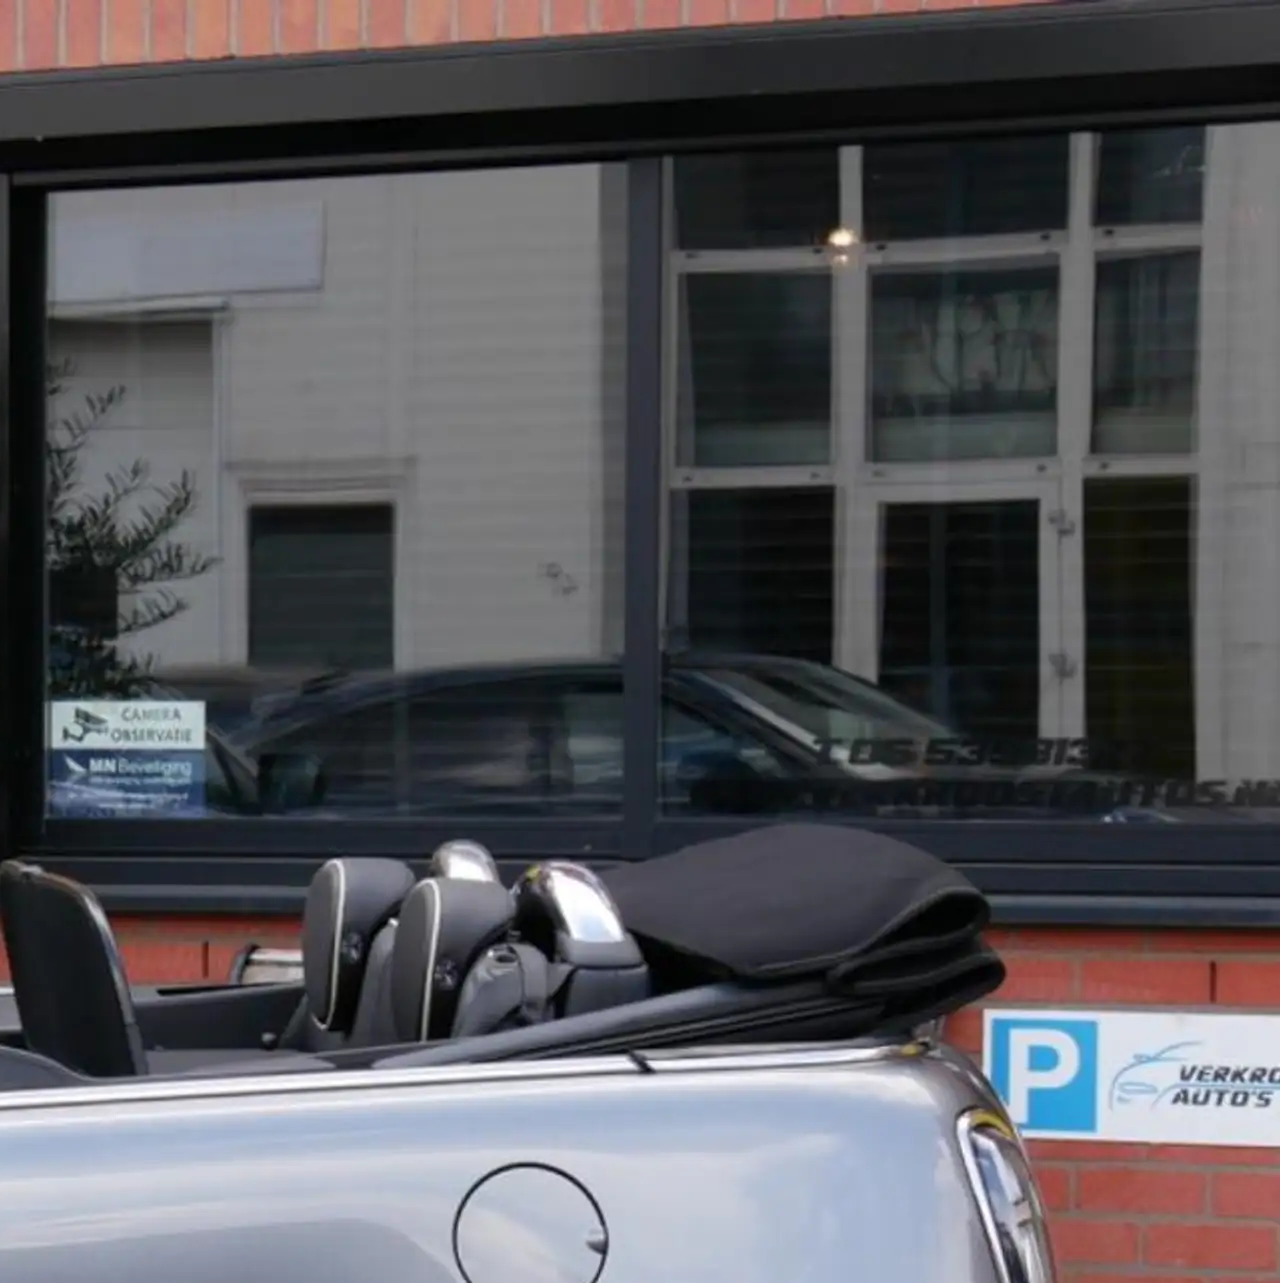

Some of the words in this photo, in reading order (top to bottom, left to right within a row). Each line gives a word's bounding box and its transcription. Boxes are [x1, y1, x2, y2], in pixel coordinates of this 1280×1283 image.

[121, 707, 182, 722] CAMERA
[110, 727, 192, 743] OBSERVATIE
[1008, 1028, 1080, 1124] P
[1171, 1088, 1274, 1108] AUTO'S
